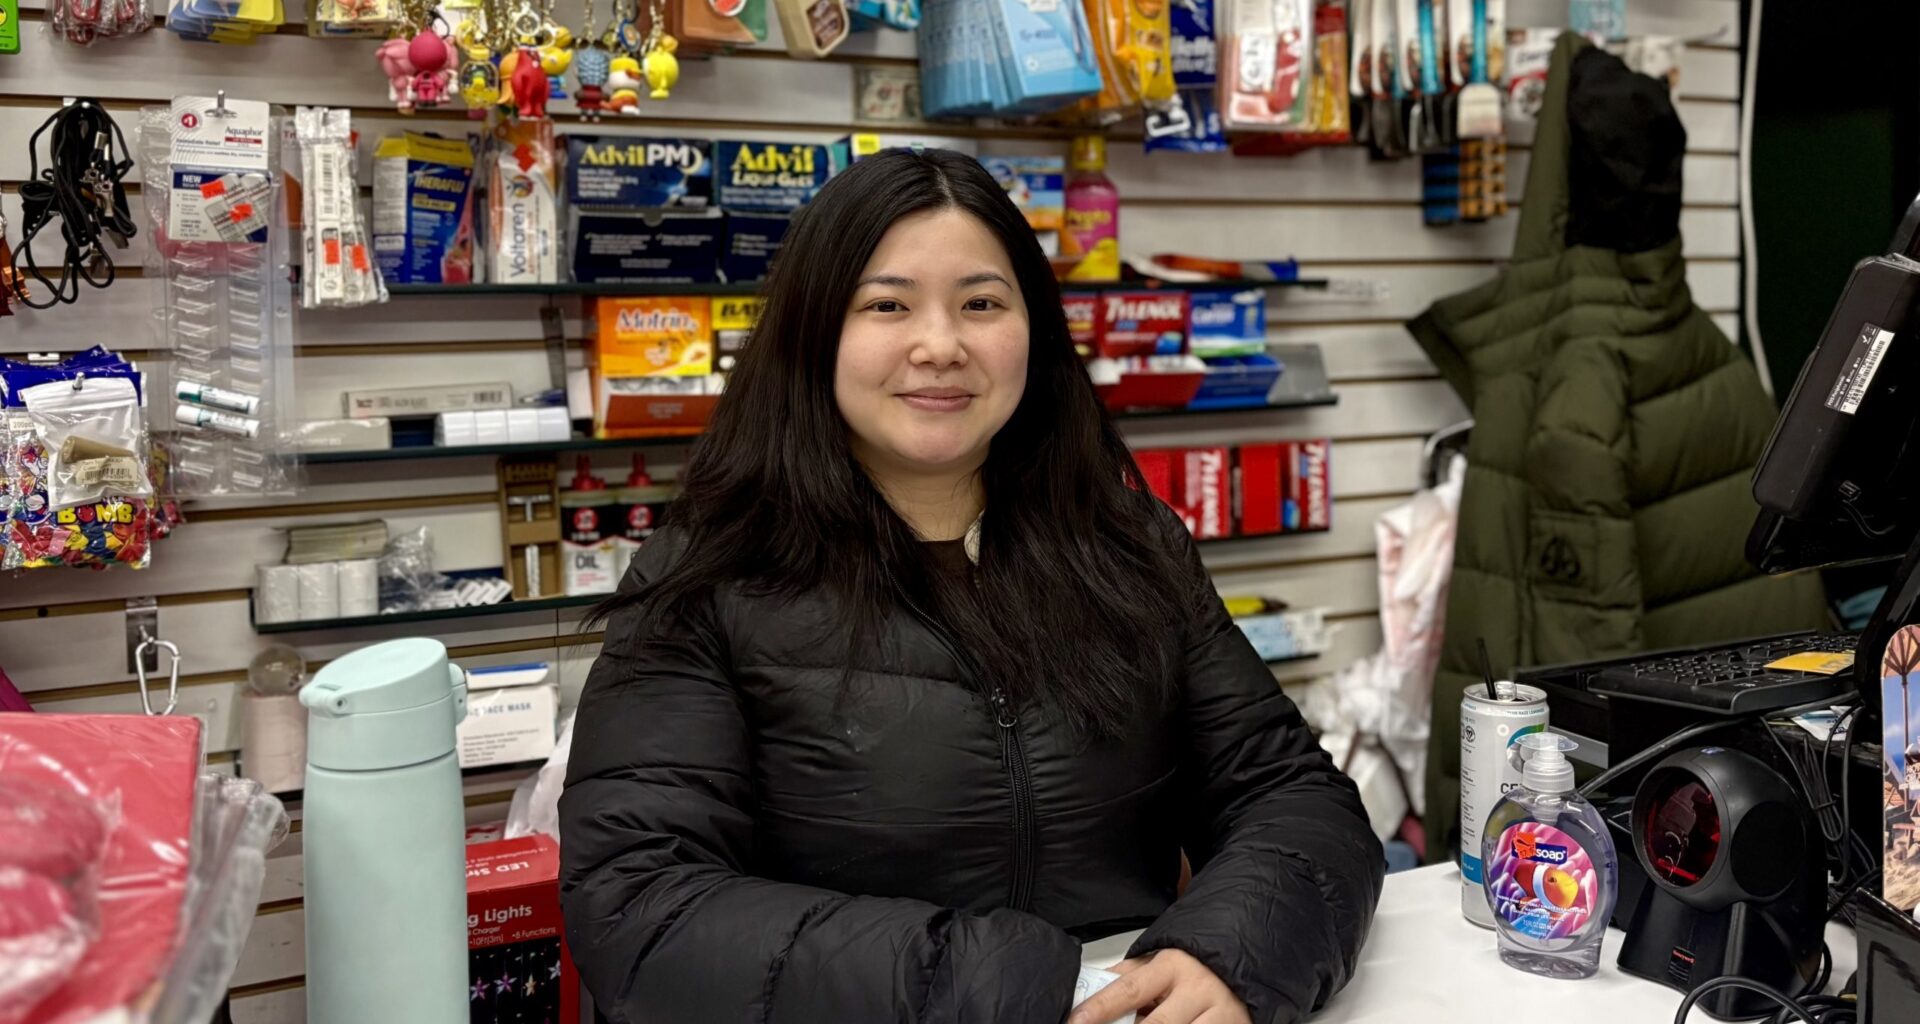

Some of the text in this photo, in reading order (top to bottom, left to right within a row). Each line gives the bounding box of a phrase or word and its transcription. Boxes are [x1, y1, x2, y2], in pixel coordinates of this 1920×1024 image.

[224, 126, 263, 139] Aquaphor
[579, 143, 690, 168] Advil PM
[730, 143, 814, 173] Advil
[182, 174, 202, 184] NEW
[510, 202, 527, 277] Voltaren
[616, 307, 690, 332] Motrin
[1105, 296, 1182, 322] TYLENOL
[1200, 449, 1221, 537] TYLENOL
[1305, 444, 1325, 527] TYLENOL
[57, 503, 133, 524] BOMB
[575, 554, 599, 569] OIL
[484, 704, 505, 714] ACE
[507, 703, 532, 713] MASK
[496, 861, 529, 872] LED
[484, 904, 533, 924] Lights
